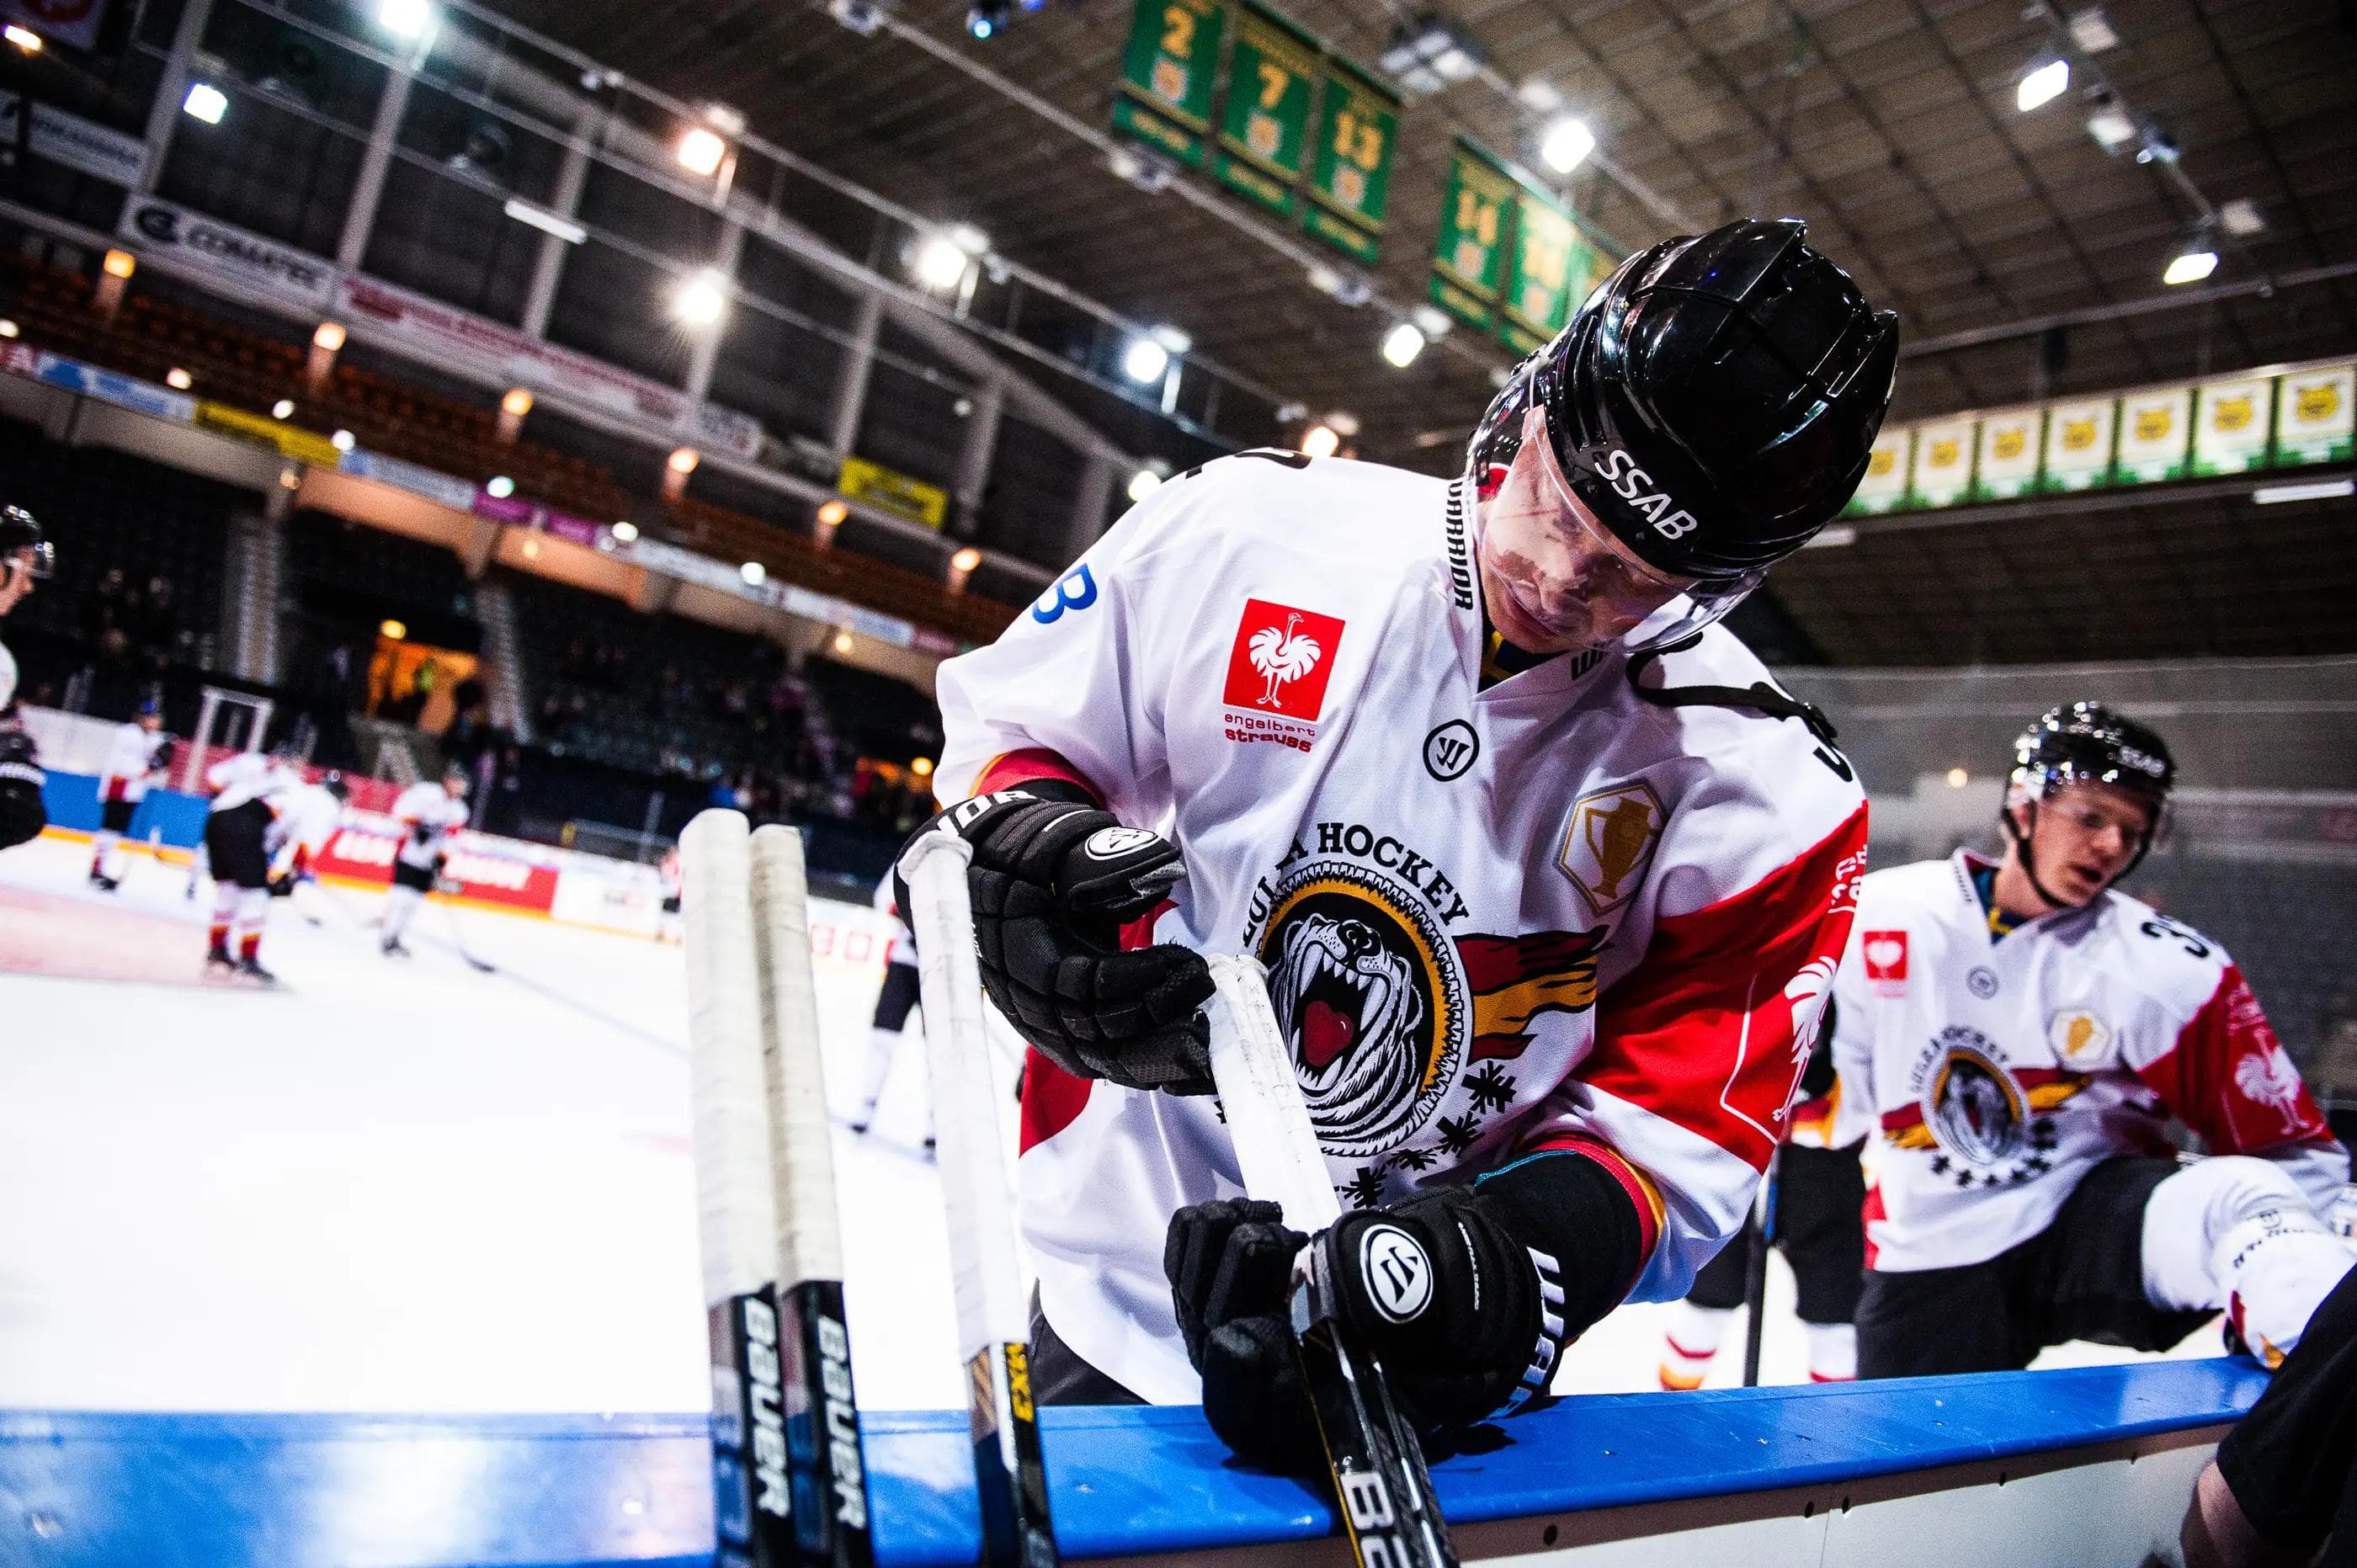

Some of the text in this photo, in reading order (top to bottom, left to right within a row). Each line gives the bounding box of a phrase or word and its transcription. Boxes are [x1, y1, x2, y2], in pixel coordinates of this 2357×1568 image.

[1594, 449, 1698, 540] SSAB
[1224, 713, 1316, 737] engelbert
[1224, 727, 1313, 753] strauss
[1317, 821, 1471, 928] HOCKEY
[743, 1295, 792, 1519] BAUER
[817, 1313, 868, 1531] BAUER
